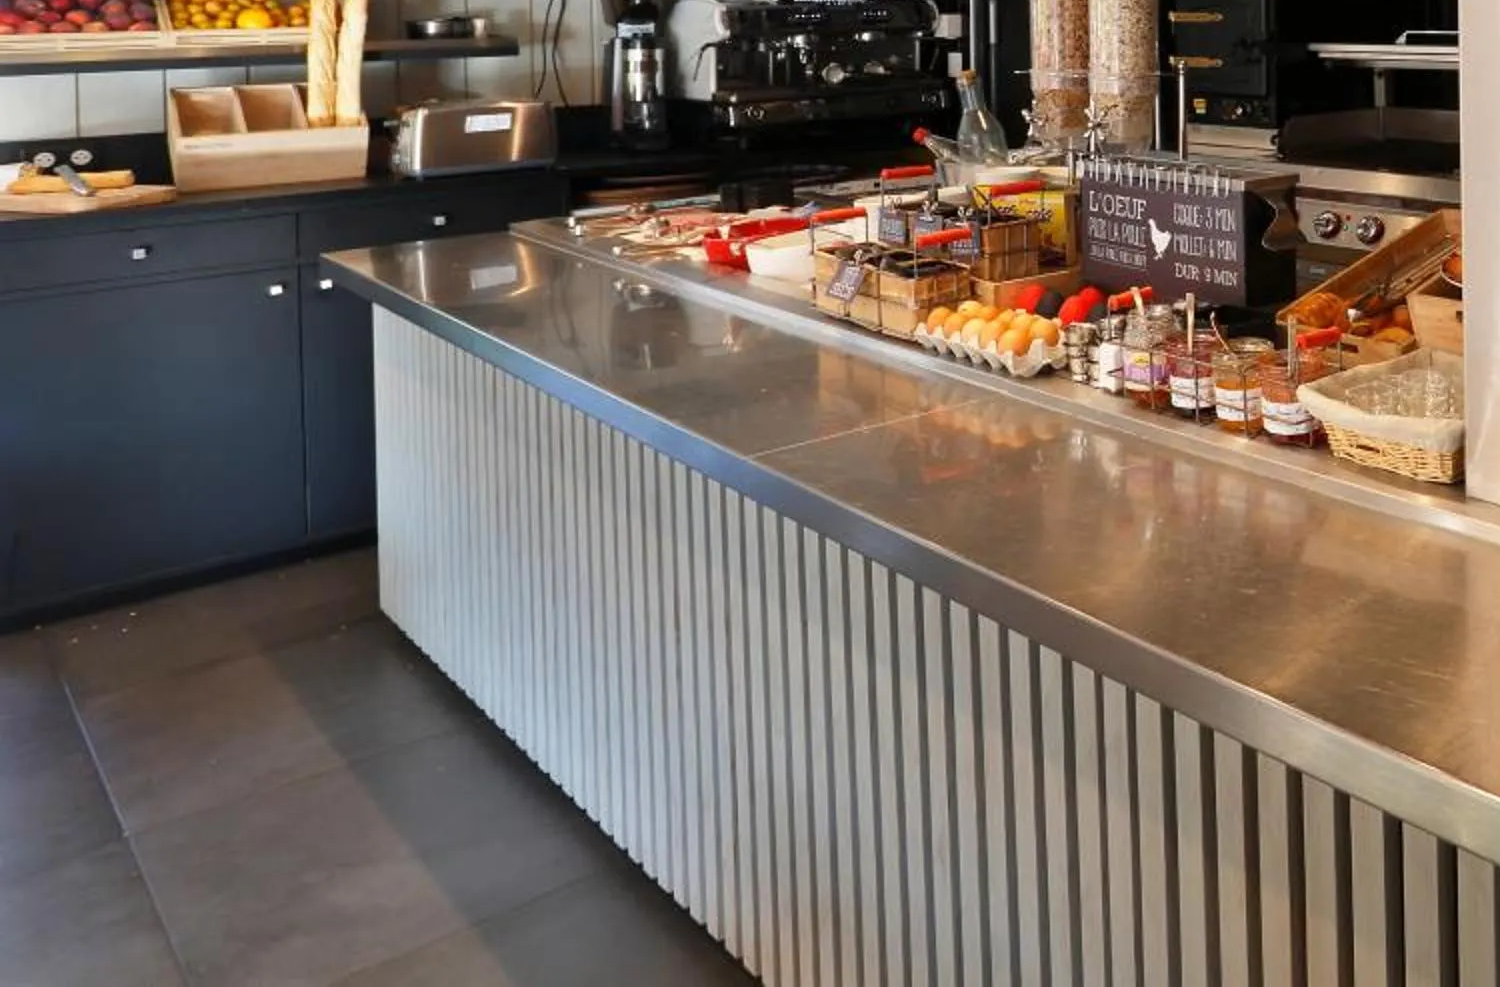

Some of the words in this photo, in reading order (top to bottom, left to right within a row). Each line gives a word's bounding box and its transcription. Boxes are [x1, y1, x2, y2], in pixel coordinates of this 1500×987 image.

[1215, 208, 1237, 232] MIN
[1217, 239, 1238, 262] MIN
[1213, 268, 1239, 288] MIN
